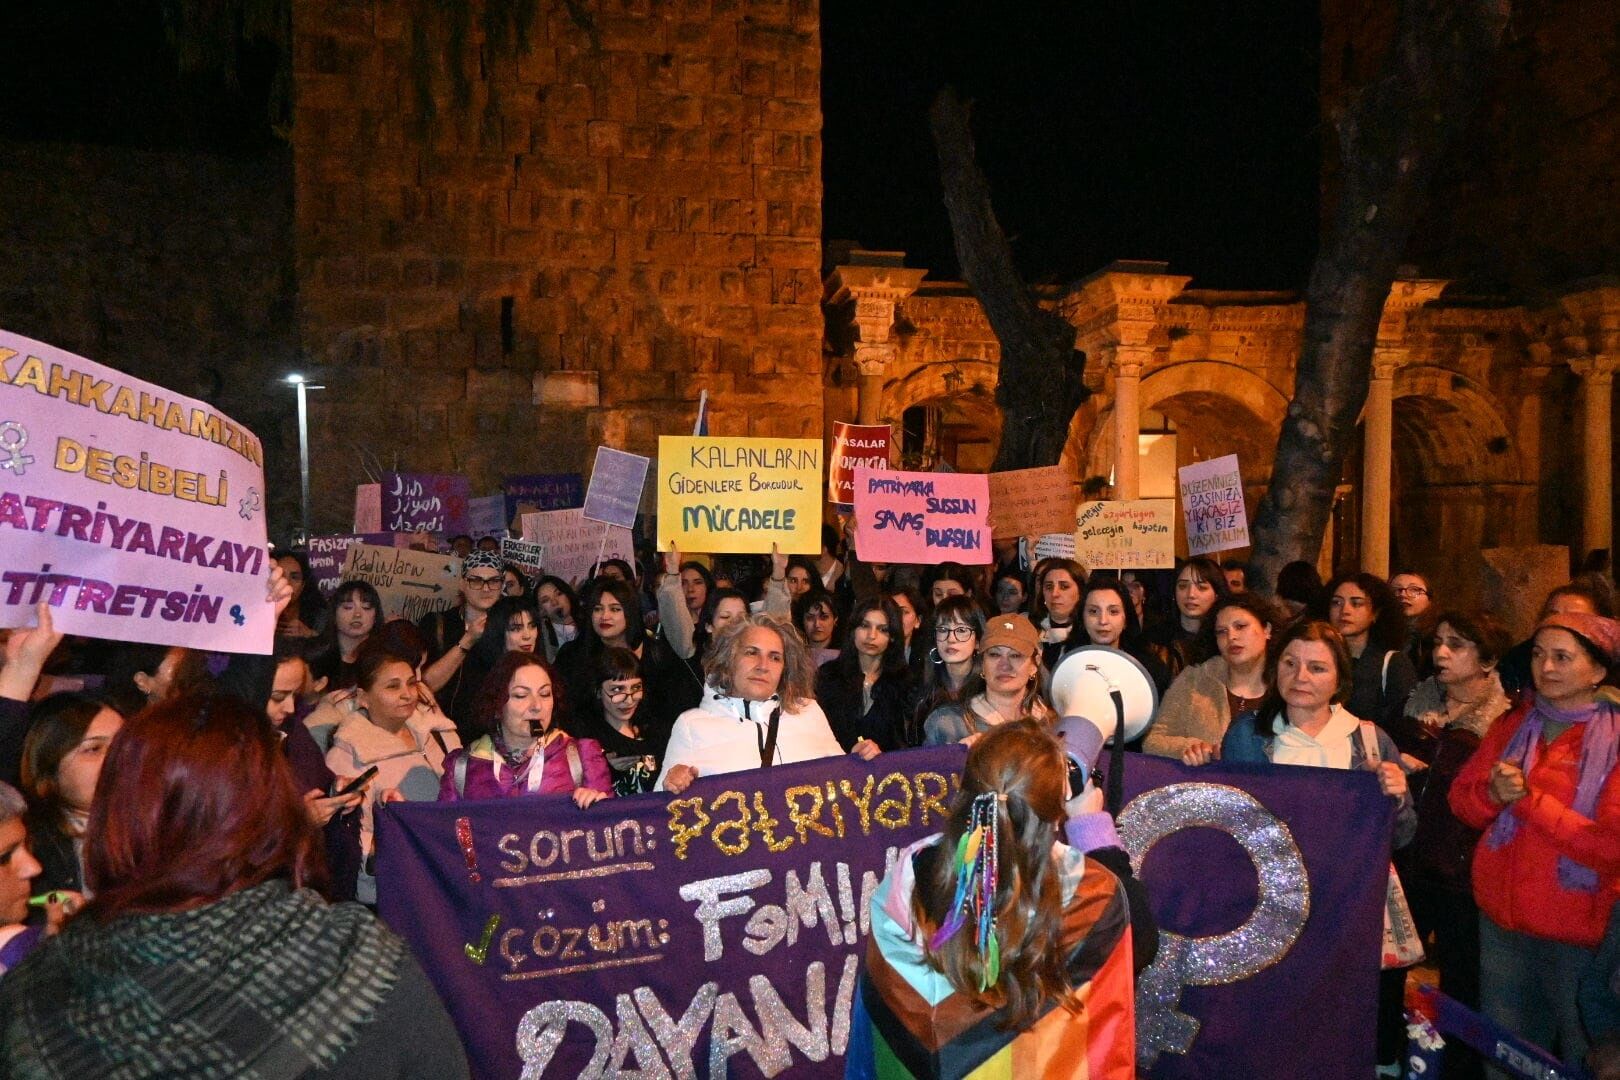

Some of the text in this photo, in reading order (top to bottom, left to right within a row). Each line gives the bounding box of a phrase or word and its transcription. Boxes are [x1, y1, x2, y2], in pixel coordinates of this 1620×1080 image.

[834, 436, 886, 449] YASALAR
[54, 436, 228, 507] DESİBELİ
[690, 446, 817, 470] KALANLARIN
[683, 504, 796, 532] MÜCADELE
[926, 498, 976, 514] SUSSUN
[0, 492, 264, 575] ATRİYARKAYI
[926, 528, 981, 549] DURSUN
[2, 564, 223, 624] TİTRETSİN
[515, 953, 860, 1080] DAYANI
